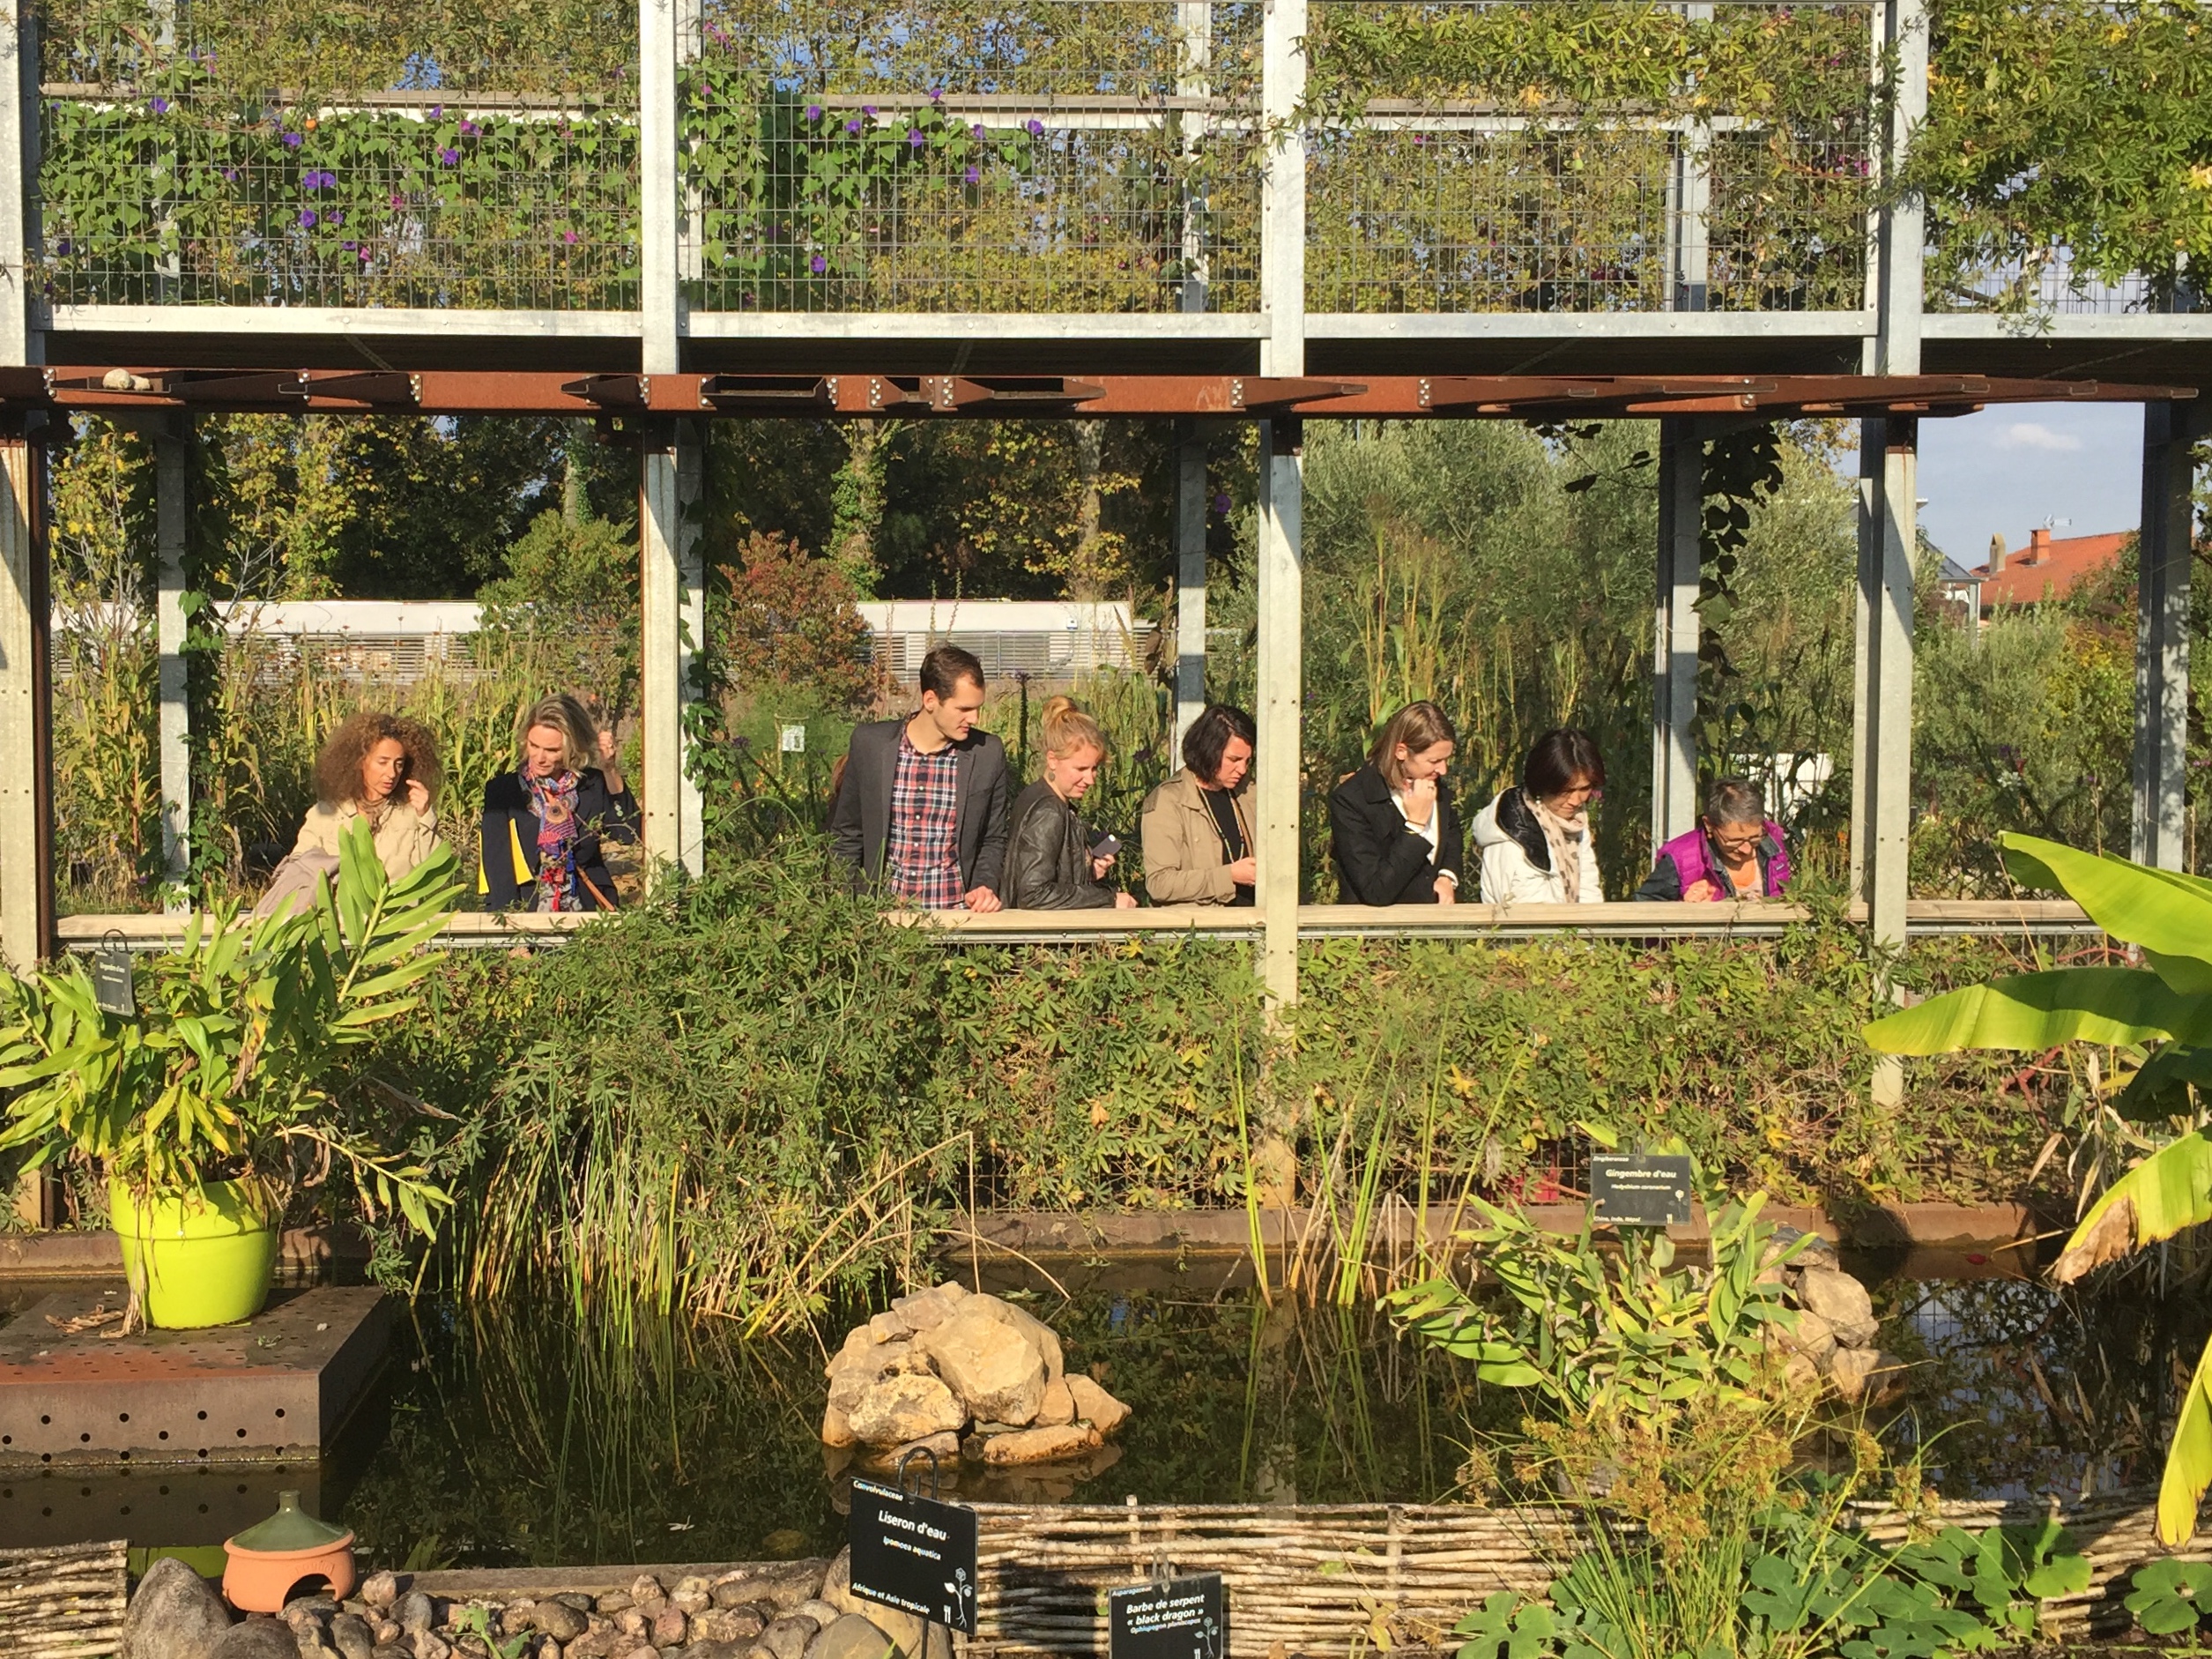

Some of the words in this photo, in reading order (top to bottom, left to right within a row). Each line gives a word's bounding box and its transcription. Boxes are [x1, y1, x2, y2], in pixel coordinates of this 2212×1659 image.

[1606, 1169, 1652, 1179] Gingembre
[1652, 1169, 1677, 1179] d'eau
[853, 1480, 903, 1501] Convolvulaceae
[879, 1510, 916, 1530] Liseron
[917, 1521, 947, 1541] d'eau
[913, 1546, 941, 1560] aquatica
[851, 1582, 877, 1597] Afrique
[886, 1594, 900, 1604] Asie
[902, 1599, 930, 1614] tropicale
[1126, 1603, 1154, 1614] Barbe
[1155, 1599, 1169, 1610] de
[1169, 1594, 1205, 1607] serpent
[1136, 1613, 1161, 1625] black
[1162, 1609, 1196, 1620] dragon
